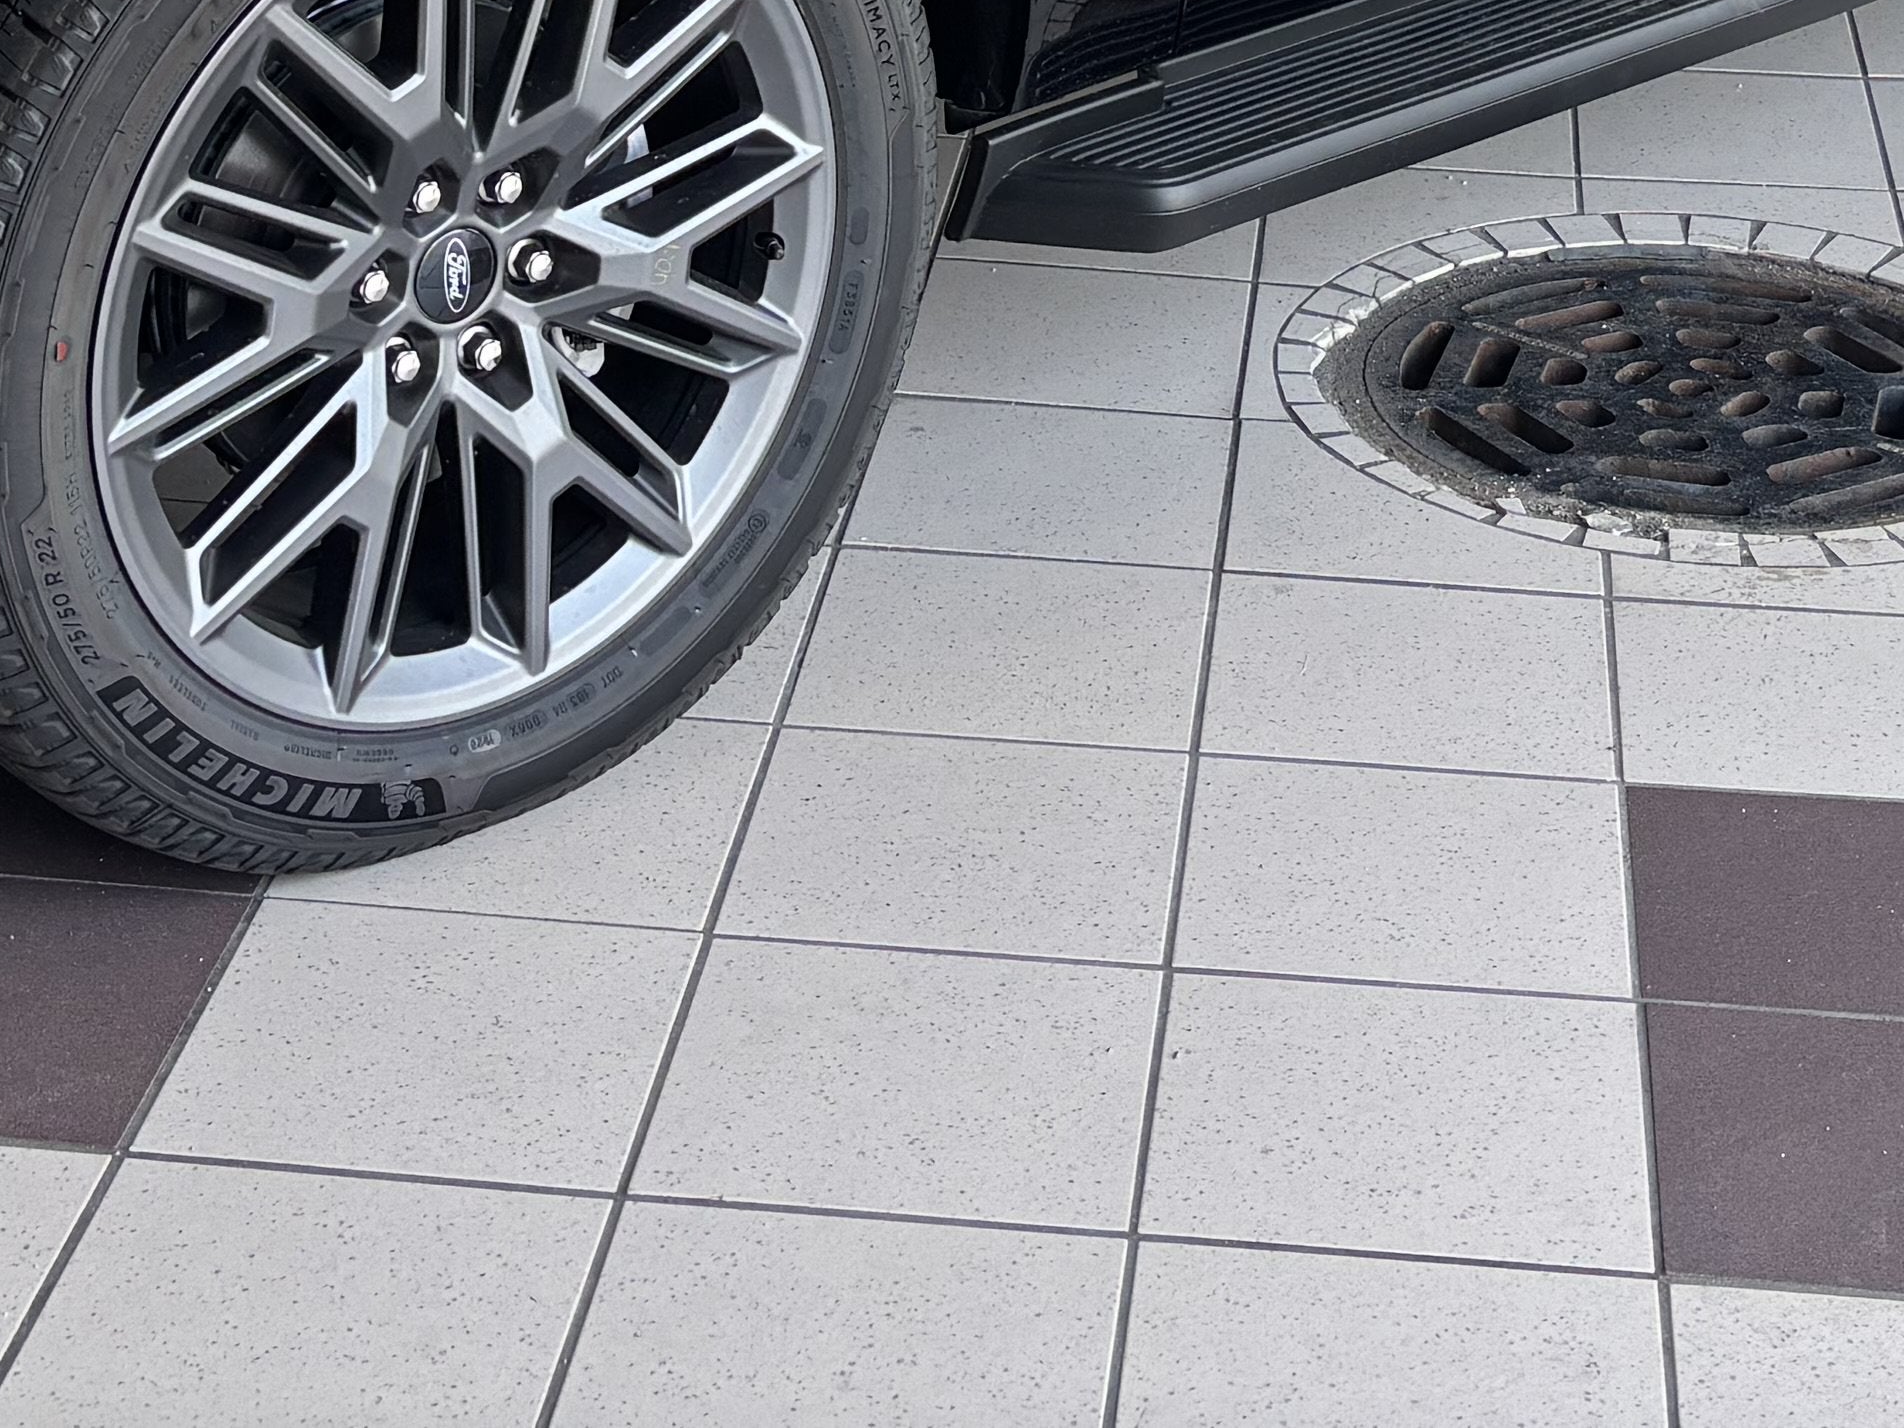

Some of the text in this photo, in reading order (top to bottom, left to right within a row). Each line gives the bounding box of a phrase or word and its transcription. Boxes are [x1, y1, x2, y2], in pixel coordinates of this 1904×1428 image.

[887, 74, 902, 102] LTX
[447, 251, 467, 301] Ford
[34, 533, 101, 666] 275/50 R 22
[111, 687, 362, 820] MICHELIN
